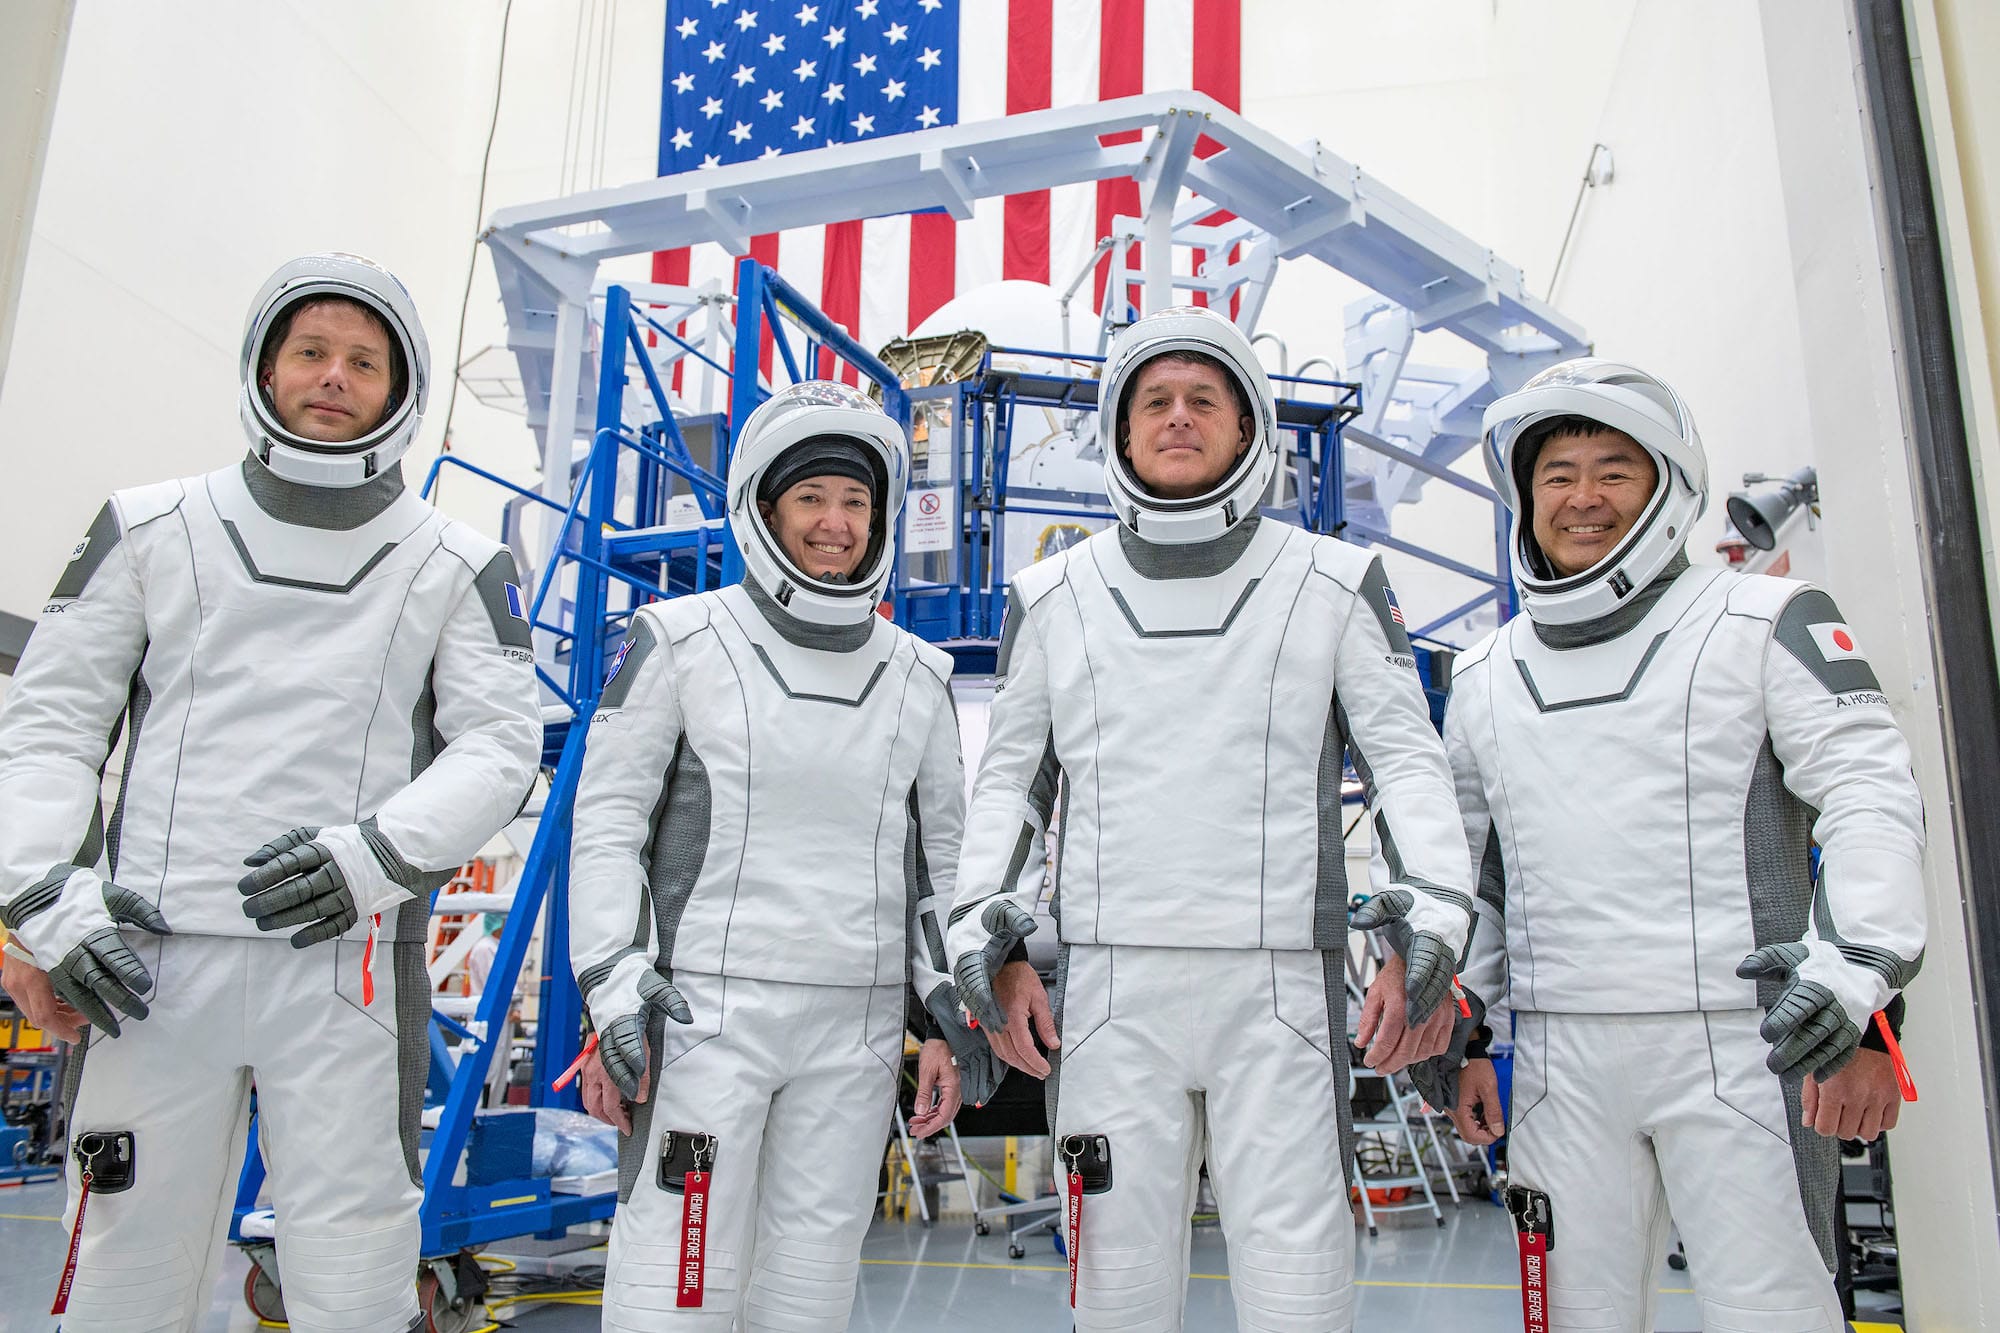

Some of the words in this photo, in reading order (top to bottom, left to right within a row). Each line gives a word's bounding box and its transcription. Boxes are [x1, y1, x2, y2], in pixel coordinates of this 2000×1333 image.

[688, 1192, 704, 1225] REMOVE
[1070, 1194, 1079, 1226] REMOVE
[687, 1227, 701, 1259] BEFORE
[684, 1261, 699, 1289] FLIGHT
[1526, 1254, 1542, 1288] REMOVE
[1528, 1289, 1543, 1322] BEFORE
